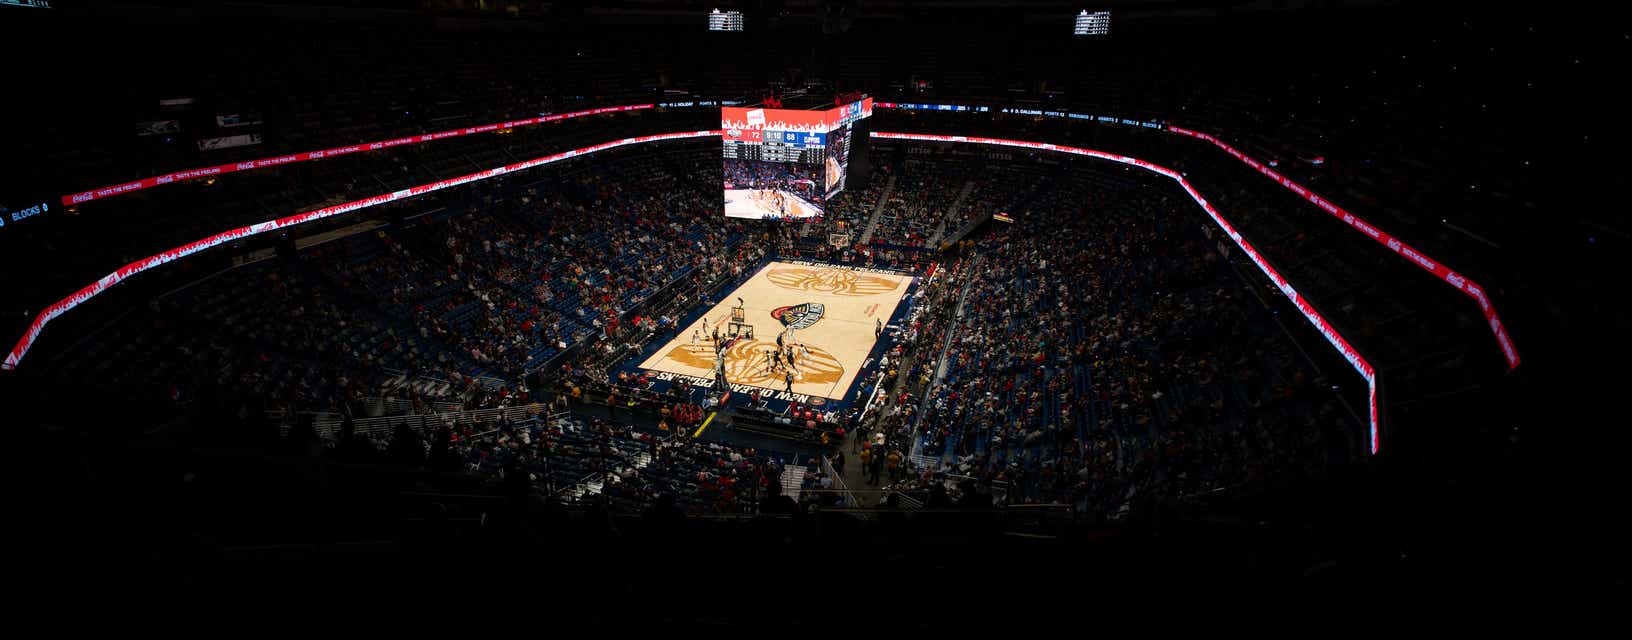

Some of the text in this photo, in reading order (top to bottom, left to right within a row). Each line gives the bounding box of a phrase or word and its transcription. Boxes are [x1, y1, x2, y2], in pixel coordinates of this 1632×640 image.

[751, 131, 761, 139] 72
[786, 133, 795, 141] 88
[97, 188, 112, 196] TASTE
[113, 185, 123, 193] THE
[123, 182, 142, 191] FEELING
[12, 205, 40, 221] BLOCKS
[774, 391, 809, 404] NEW
